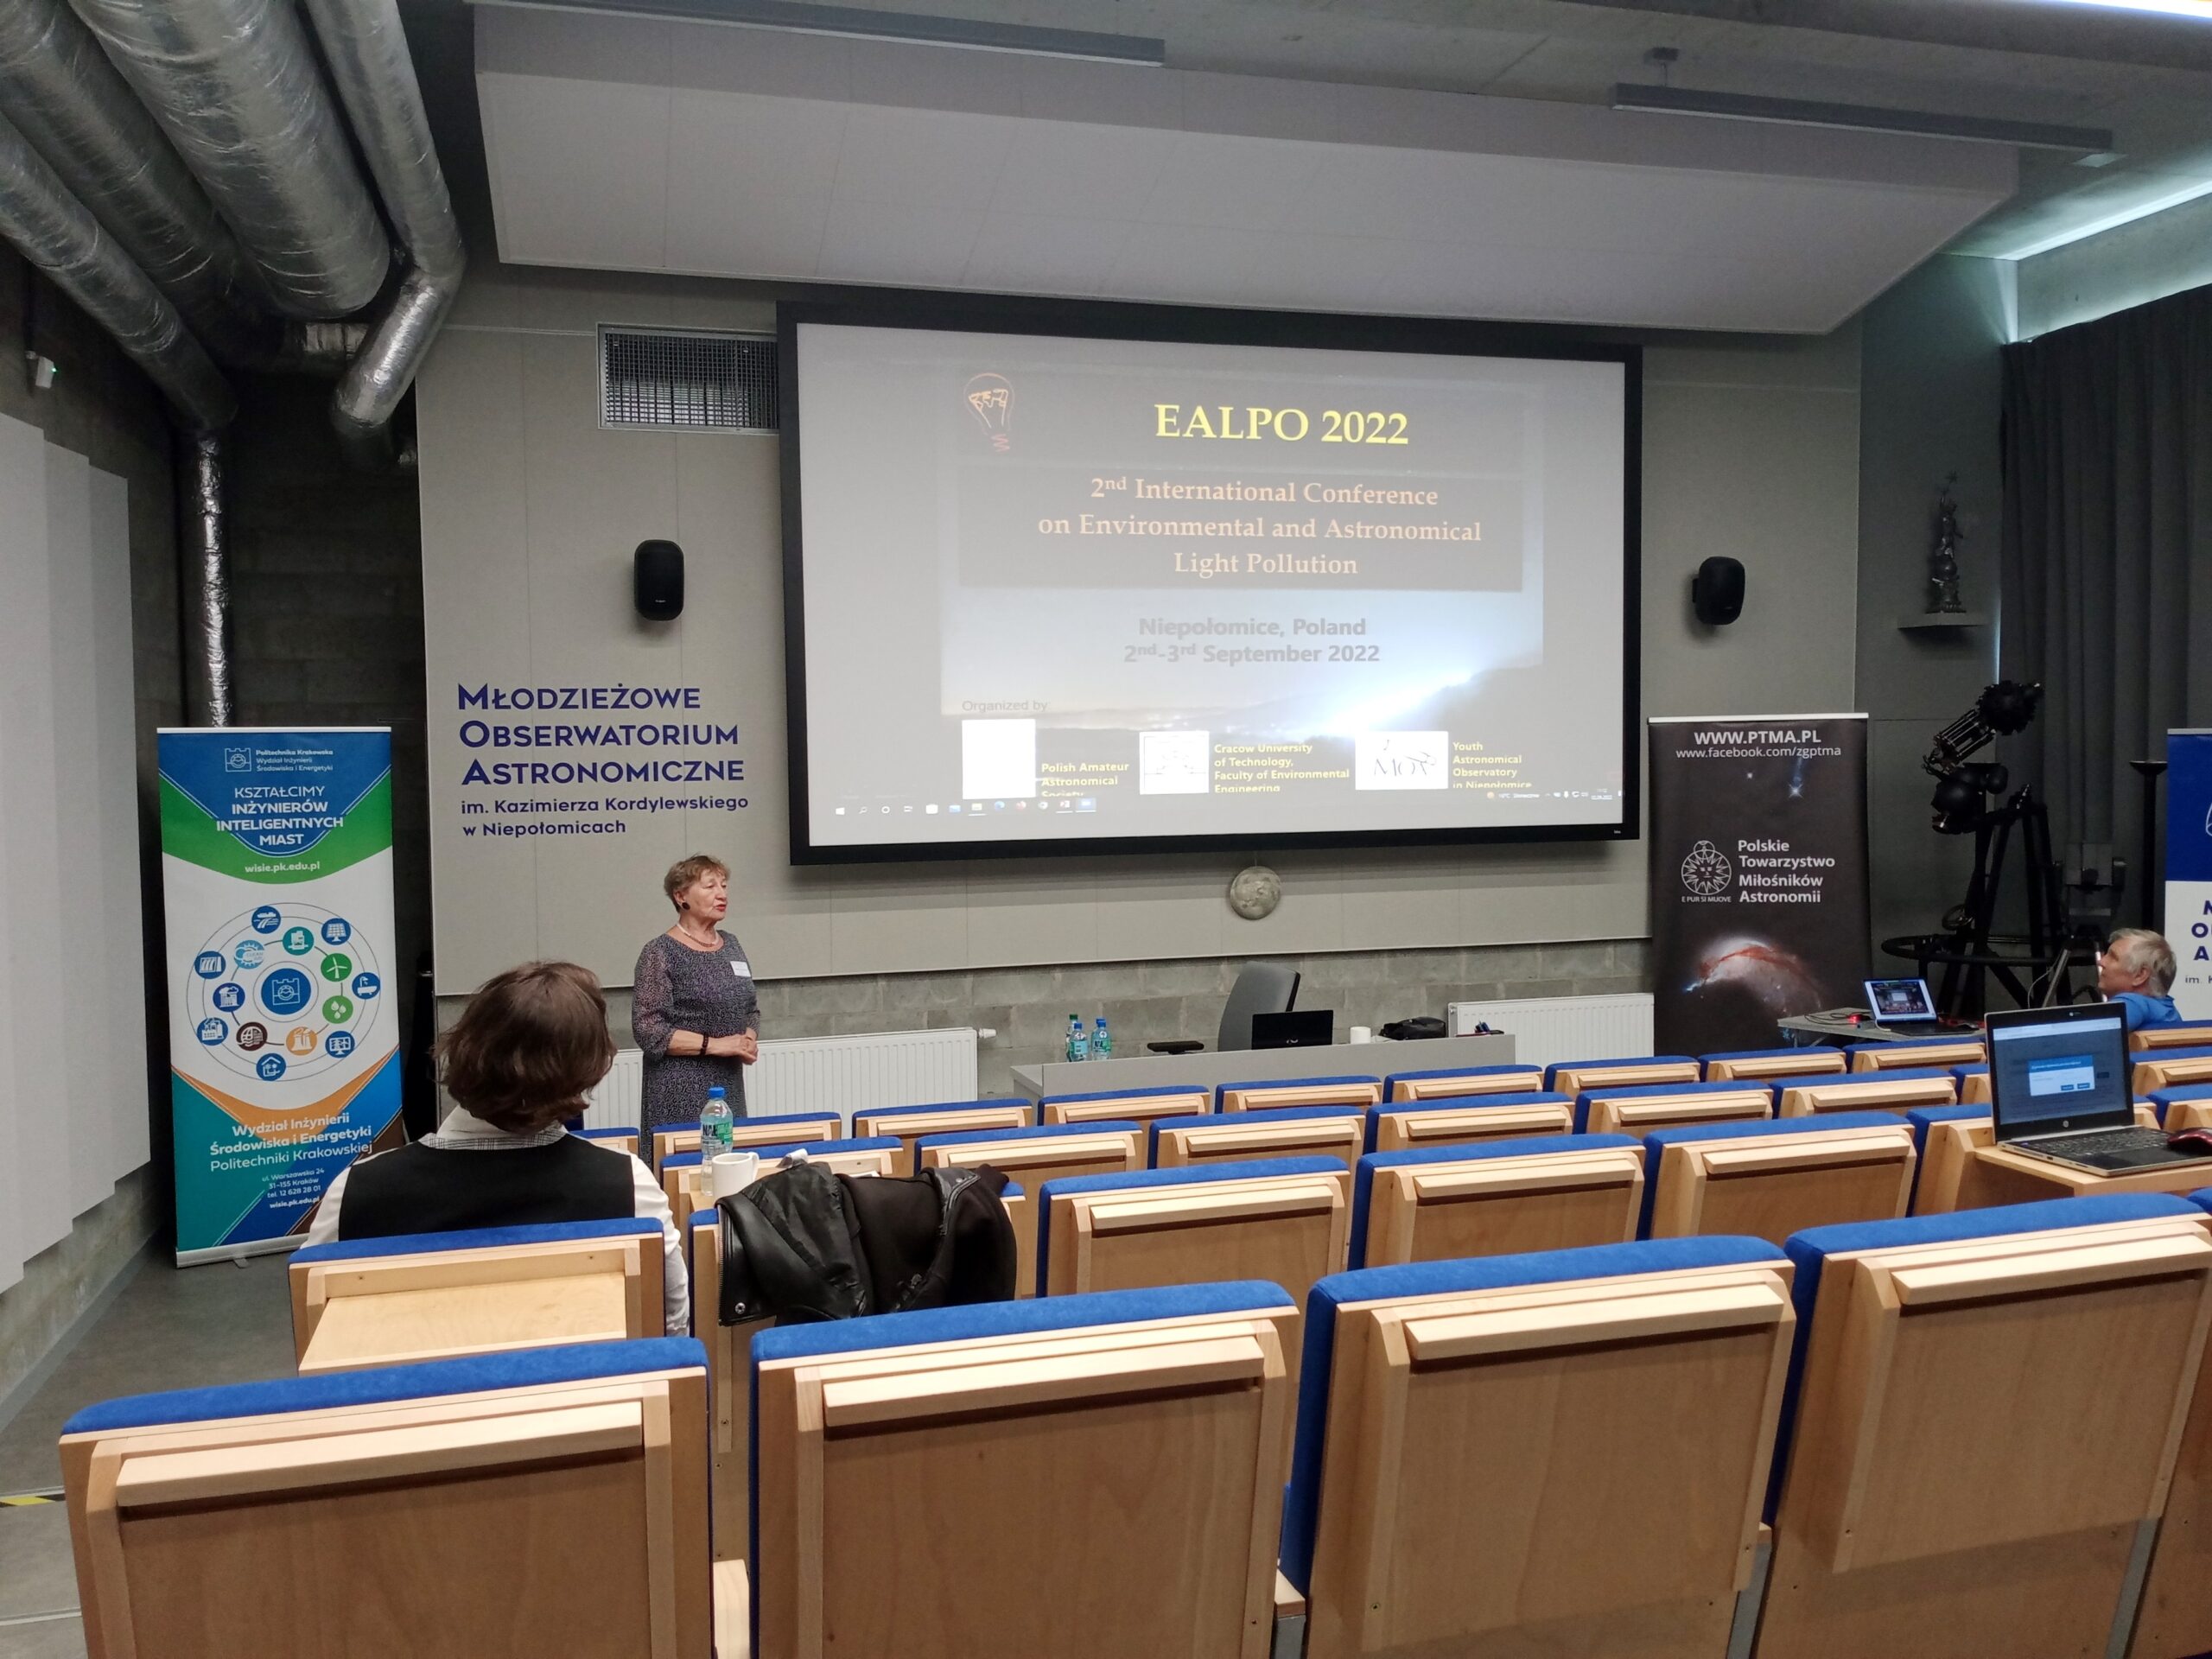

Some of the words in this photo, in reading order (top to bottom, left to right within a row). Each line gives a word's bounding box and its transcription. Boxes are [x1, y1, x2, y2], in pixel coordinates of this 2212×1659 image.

[1154, 404, 1309, 442] EALPO
[1320, 410, 1408, 445] 2022
[1090, 476, 1127, 498] 2nd
[1135, 478, 1296, 502] International
[1303, 482, 1438, 505] Conference
[1039, 518, 1071, 534] on
[1079, 514, 1264, 537] Environmental
[1272, 518, 1316, 537] and
[1324, 518, 1481, 541] Astronomical
[1173, 552, 1239, 579] Light
[1247, 553, 1358, 575] Pollution
[1138, 618, 1285, 640] Niepołomice,
[1293, 618, 1366, 636] Poland
[1203, 645, 1322, 667] September
[1328, 645, 1381, 663] 2022
[458, 683, 701, 710] MŁODZIEŻOWE
[962, 699, 1029, 713] Organized
[460, 720, 738, 748] OBSERWATORIUM
[1694, 730, 1821, 745] WWW.PTMA.PL
[1214, 744, 1255, 753] Cracow
[1257, 743, 1313, 754] University
[1452, 741, 1484, 751] Youth
[1675, 746, 1842, 760] www.facebook.com/zgptma
[1214, 758, 1226, 767] of
[1228, 757, 1294, 768] Technology,
[1452, 754, 1522, 764] Astronomical
[461, 759, 745, 785] ASTRONOMICZNE
[1041, 762, 1076, 772] Polish
[1079, 762, 1129, 772] Amateur
[1452, 767, 1517, 779] Observatory
[1041, 775, 1118, 786] Astronomical
[1214, 771, 1253, 782] Faculty
[1256, 770, 1268, 779] of
[1271, 769, 1350, 779] Environmental
[234, 785, 325, 798] KSZTAŁCIMY
[232, 798, 328, 815] INŻYNIERÓW
[461, 800, 489, 814] im.
[494, 798, 599, 814] Kazimierza
[605, 796, 748, 814] Kordylewskiego
[216, 817, 344, 831] INTELIGENTNYCH
[462, 825, 476, 836] w
[483, 820, 626, 837] Niepołomicach
[259, 834, 304, 846] MIAST
[1738, 839, 1790, 852] Polskie
[245, 861, 321, 874] wisie.pk.edu.pl
[1738, 855, 1835, 870] Towarzystwo
[1738, 874, 1824, 887] Miłośników
[1738, 890, 1821, 903] Astronomii
[232, 1118, 288, 1137] Wydział
[290, 1112, 350, 1129] Inżynierii
[210, 1137, 290, 1156] Środowiska
[292, 1136, 297, 1145] i
[300, 1125, 372, 1144] Energetyki
[210, 1152, 289, 1172] Politechniki
[293, 1141, 373, 1161] Krakowskiej
[270, 1170, 315, 1180] Warszawska
[292, 1178, 319, 1186] Kraków
[270, 1196, 320, 1209] wisie.pk.edu.pl
